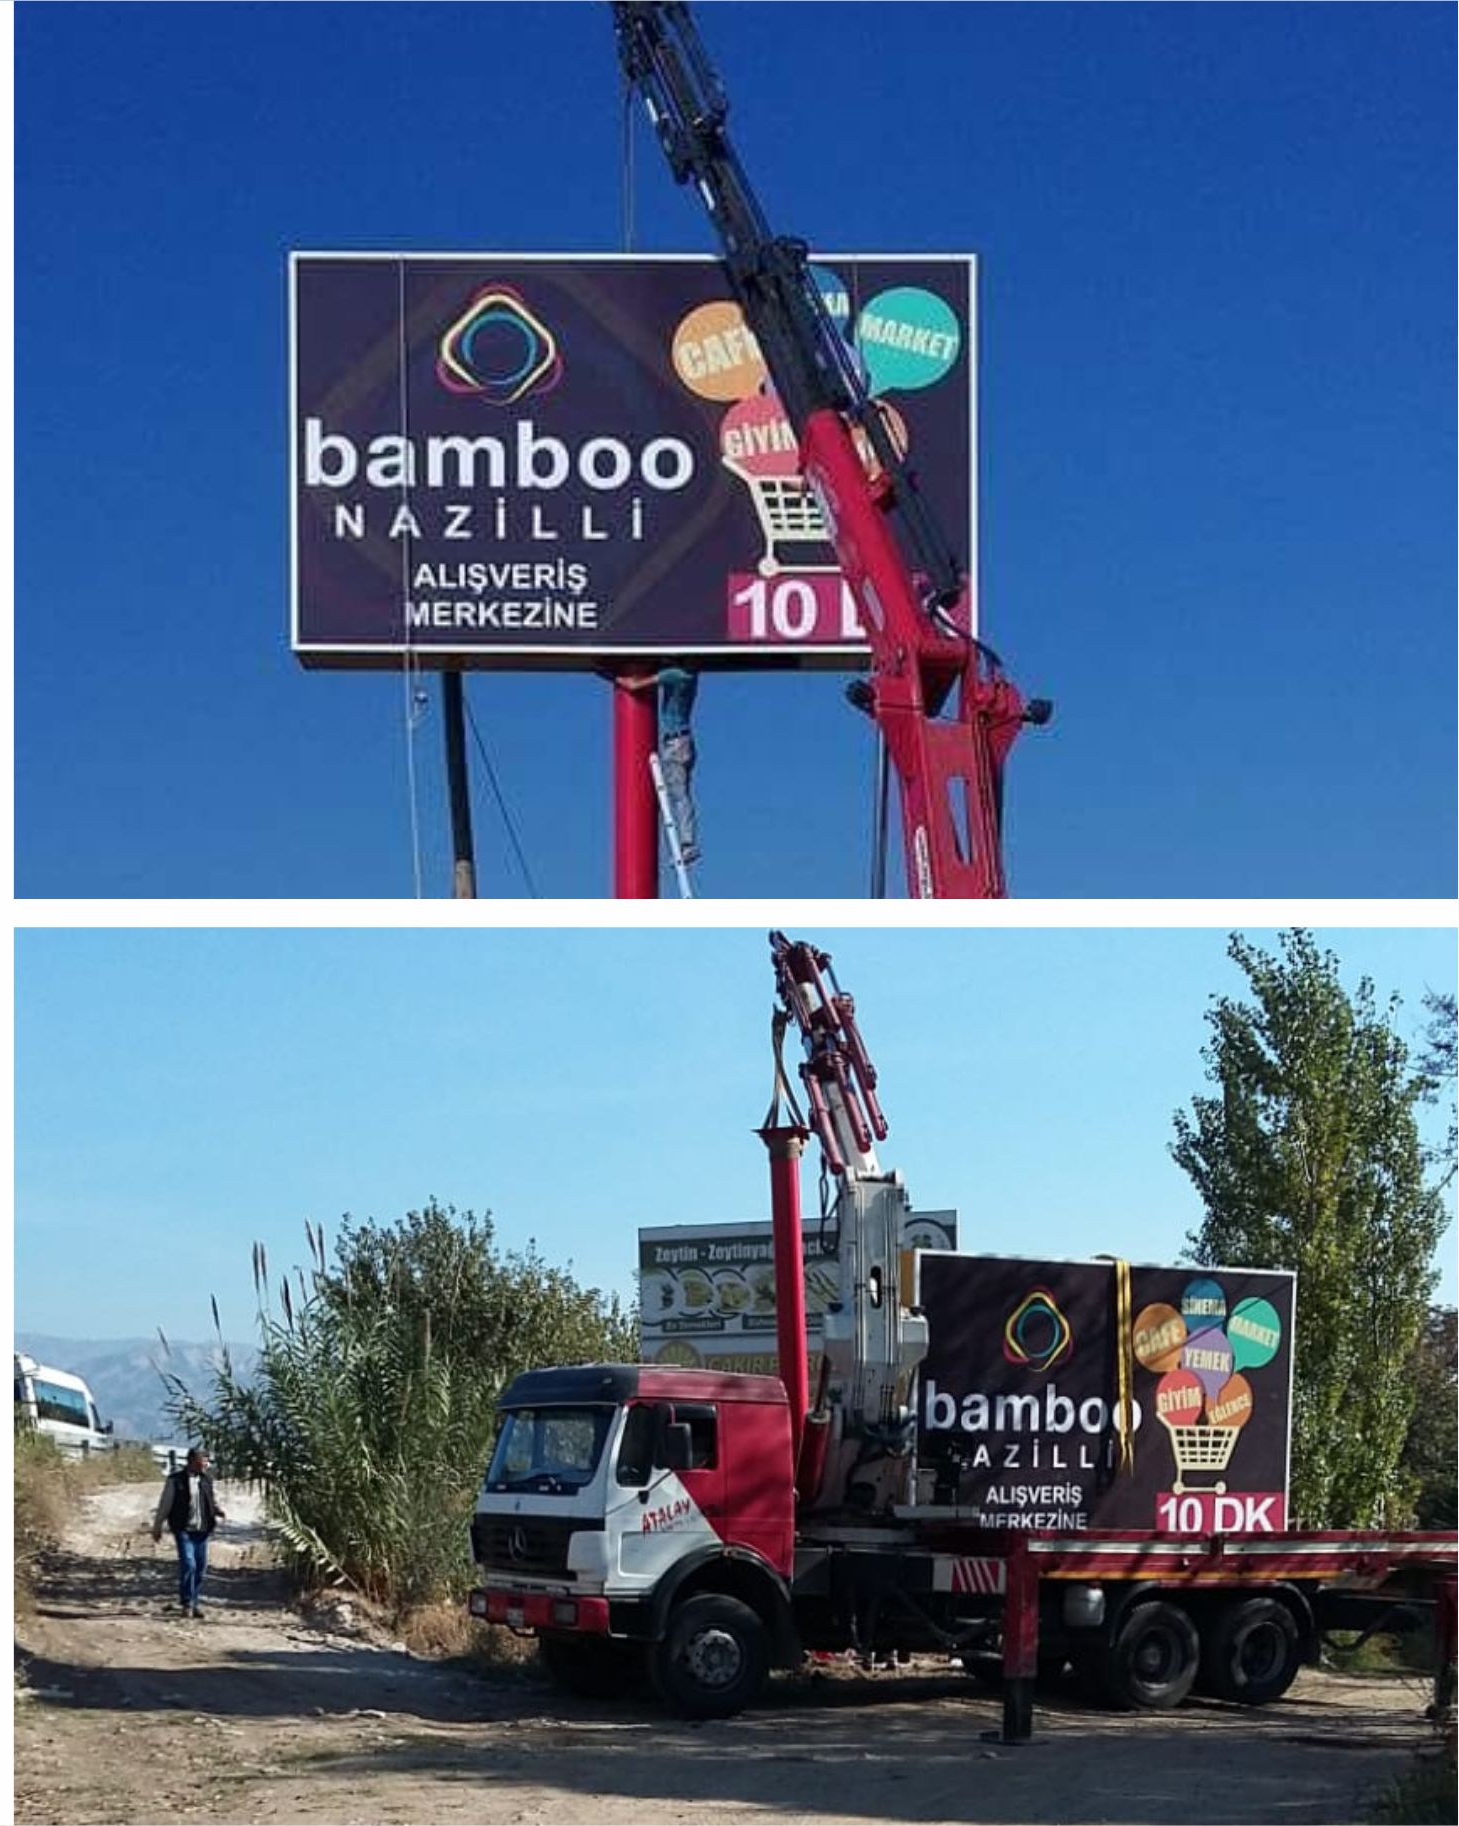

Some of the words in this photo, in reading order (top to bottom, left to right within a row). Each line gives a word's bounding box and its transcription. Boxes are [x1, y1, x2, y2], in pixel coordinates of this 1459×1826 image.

[860, 314, 959, 360] MARKET
[305, 418, 695, 489] bamboo
[336, 498, 643, 540] NAZİLLİ
[414, 557, 589, 593] ALIŞVERİŞ
[405, 594, 598, 629] MERKEZİNE
[734, 579, 817, 639] 10
[655, 1245, 698, 1263] Zeytin
[1183, 1347, 1231, 1373] YEMEK
[925, 1380, 1143, 1433] bamboo
[1157, 1385, 1202, 1413] GİYİM
[961, 1438, 1114, 1471] AZİLLİ
[986, 1482, 1083, 1508] ALIŞVERİŞ
[1160, 1497, 1203, 1532] 10
[1214, 1497, 1276, 1532] DK
